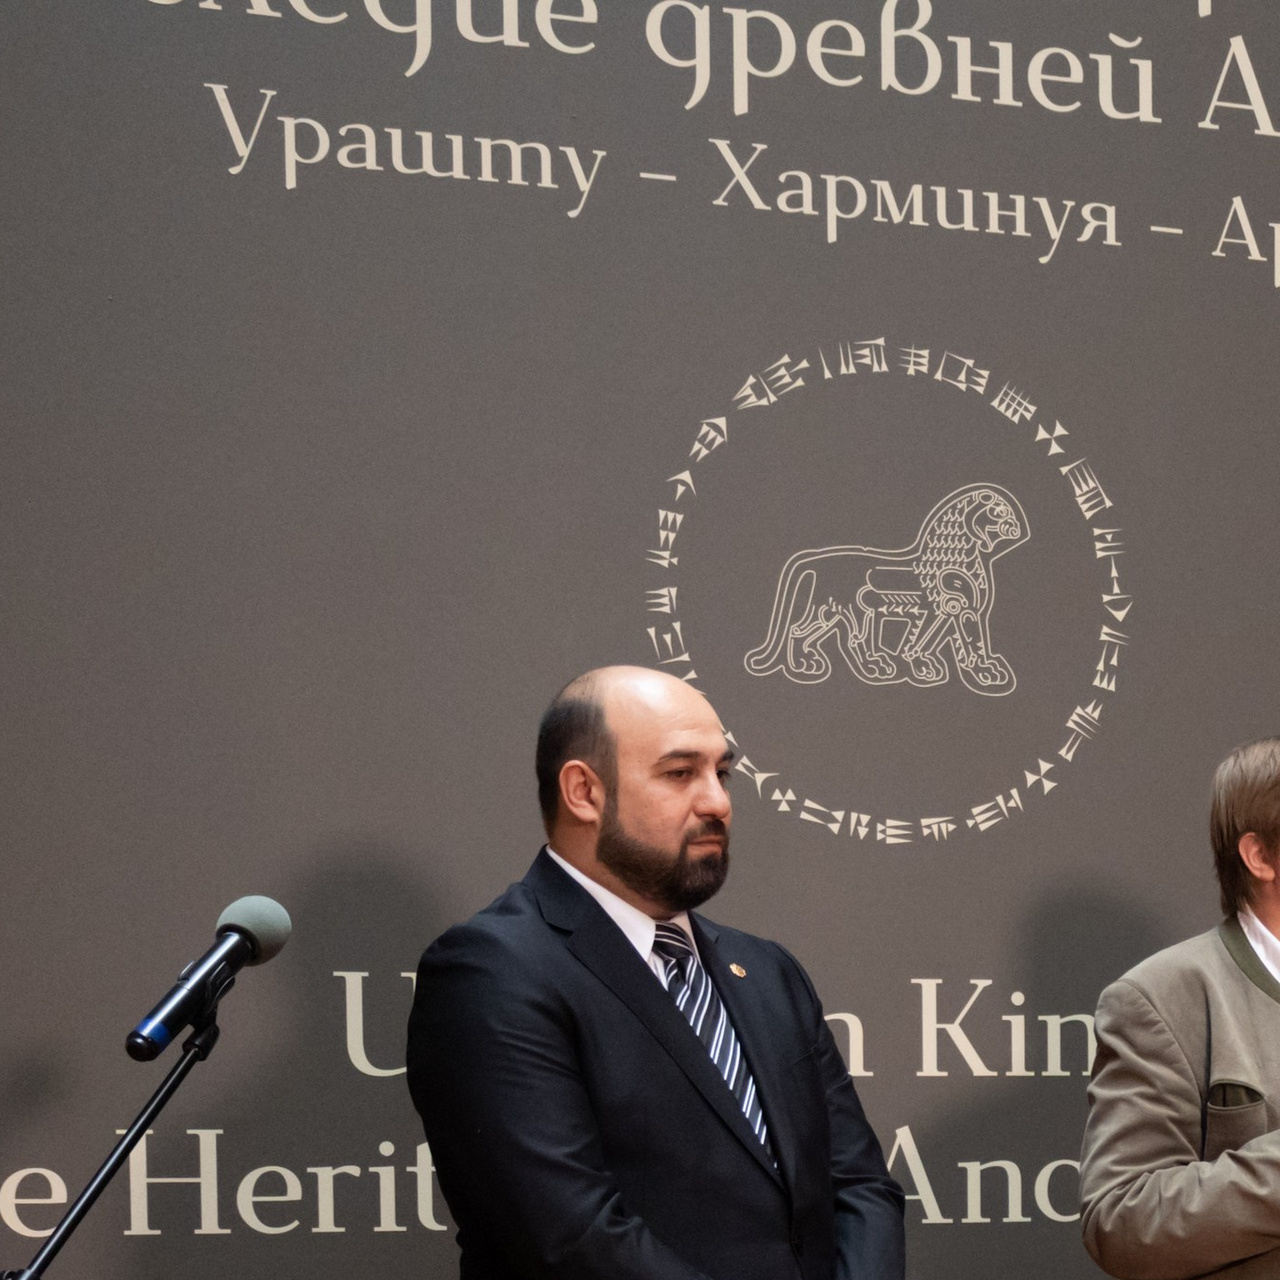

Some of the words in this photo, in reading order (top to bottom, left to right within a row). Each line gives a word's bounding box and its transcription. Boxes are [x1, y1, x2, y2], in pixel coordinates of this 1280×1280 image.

[645, 0, 1163, 117] древней
[203, 82, 607, 219] Урашту
[707, 138, 1122, 264] Харминуя
[910, 978, 1094, 1077] Kin
[115, 1128, 448, 1236] Herit
[887, 1124, 1081, 1224] Anc
